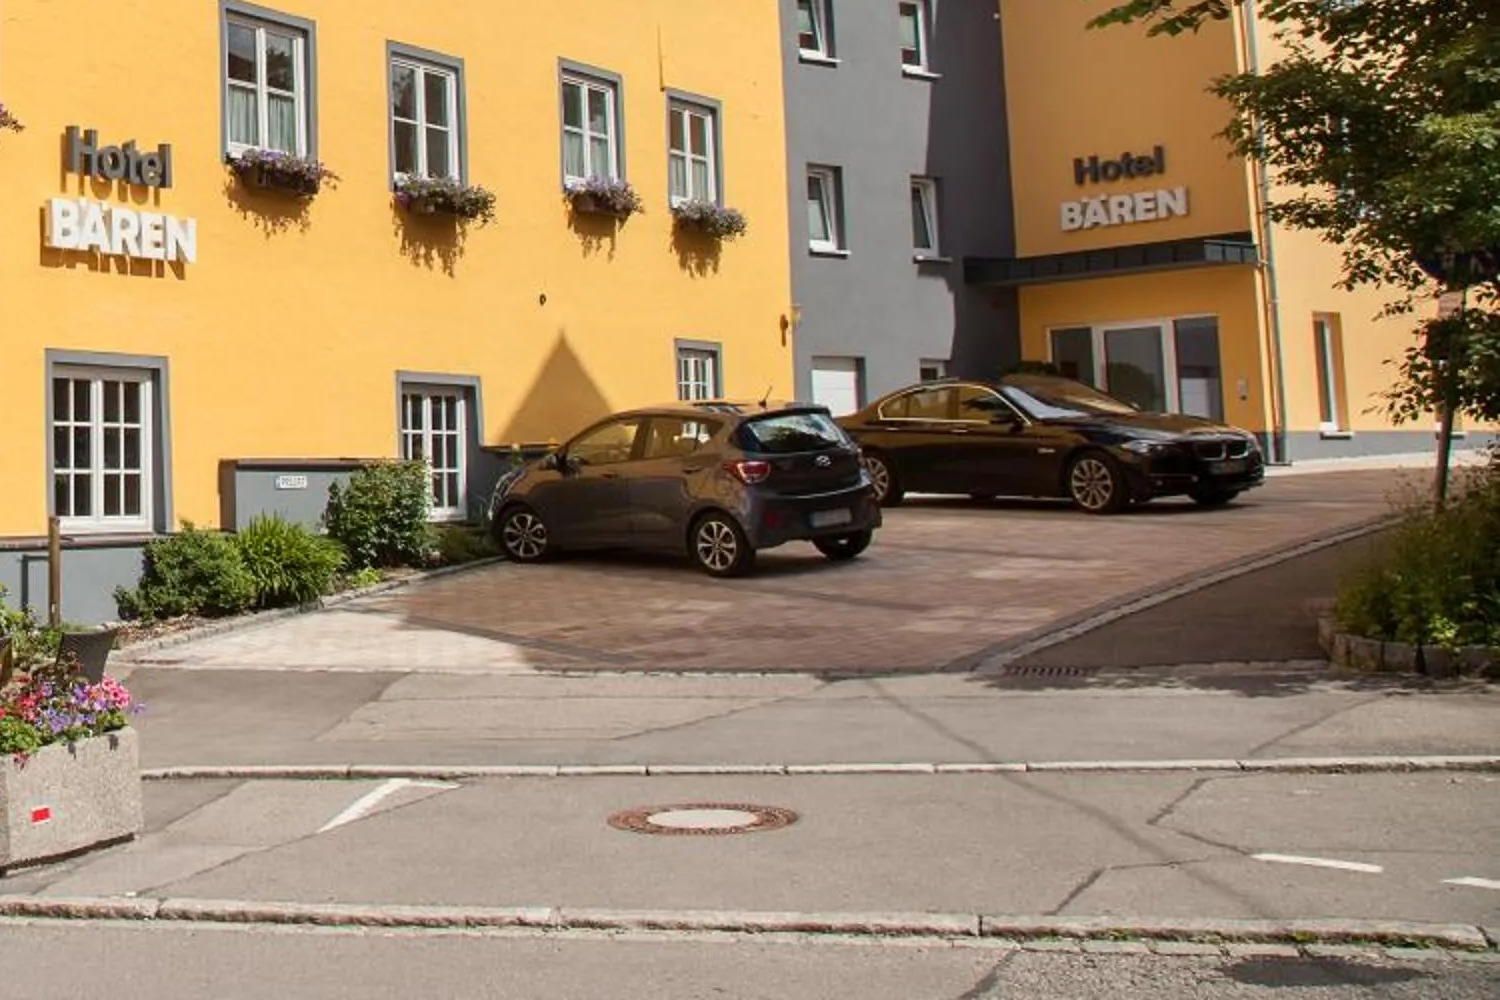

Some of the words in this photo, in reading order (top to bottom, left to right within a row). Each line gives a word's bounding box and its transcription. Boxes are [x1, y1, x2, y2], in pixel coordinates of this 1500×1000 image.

[65, 125, 172, 188] Hotel
[1073, 145, 1165, 185] Hotel
[45, 197, 197, 264] BÄREN
[1060, 184, 1188, 231] BÄREN
